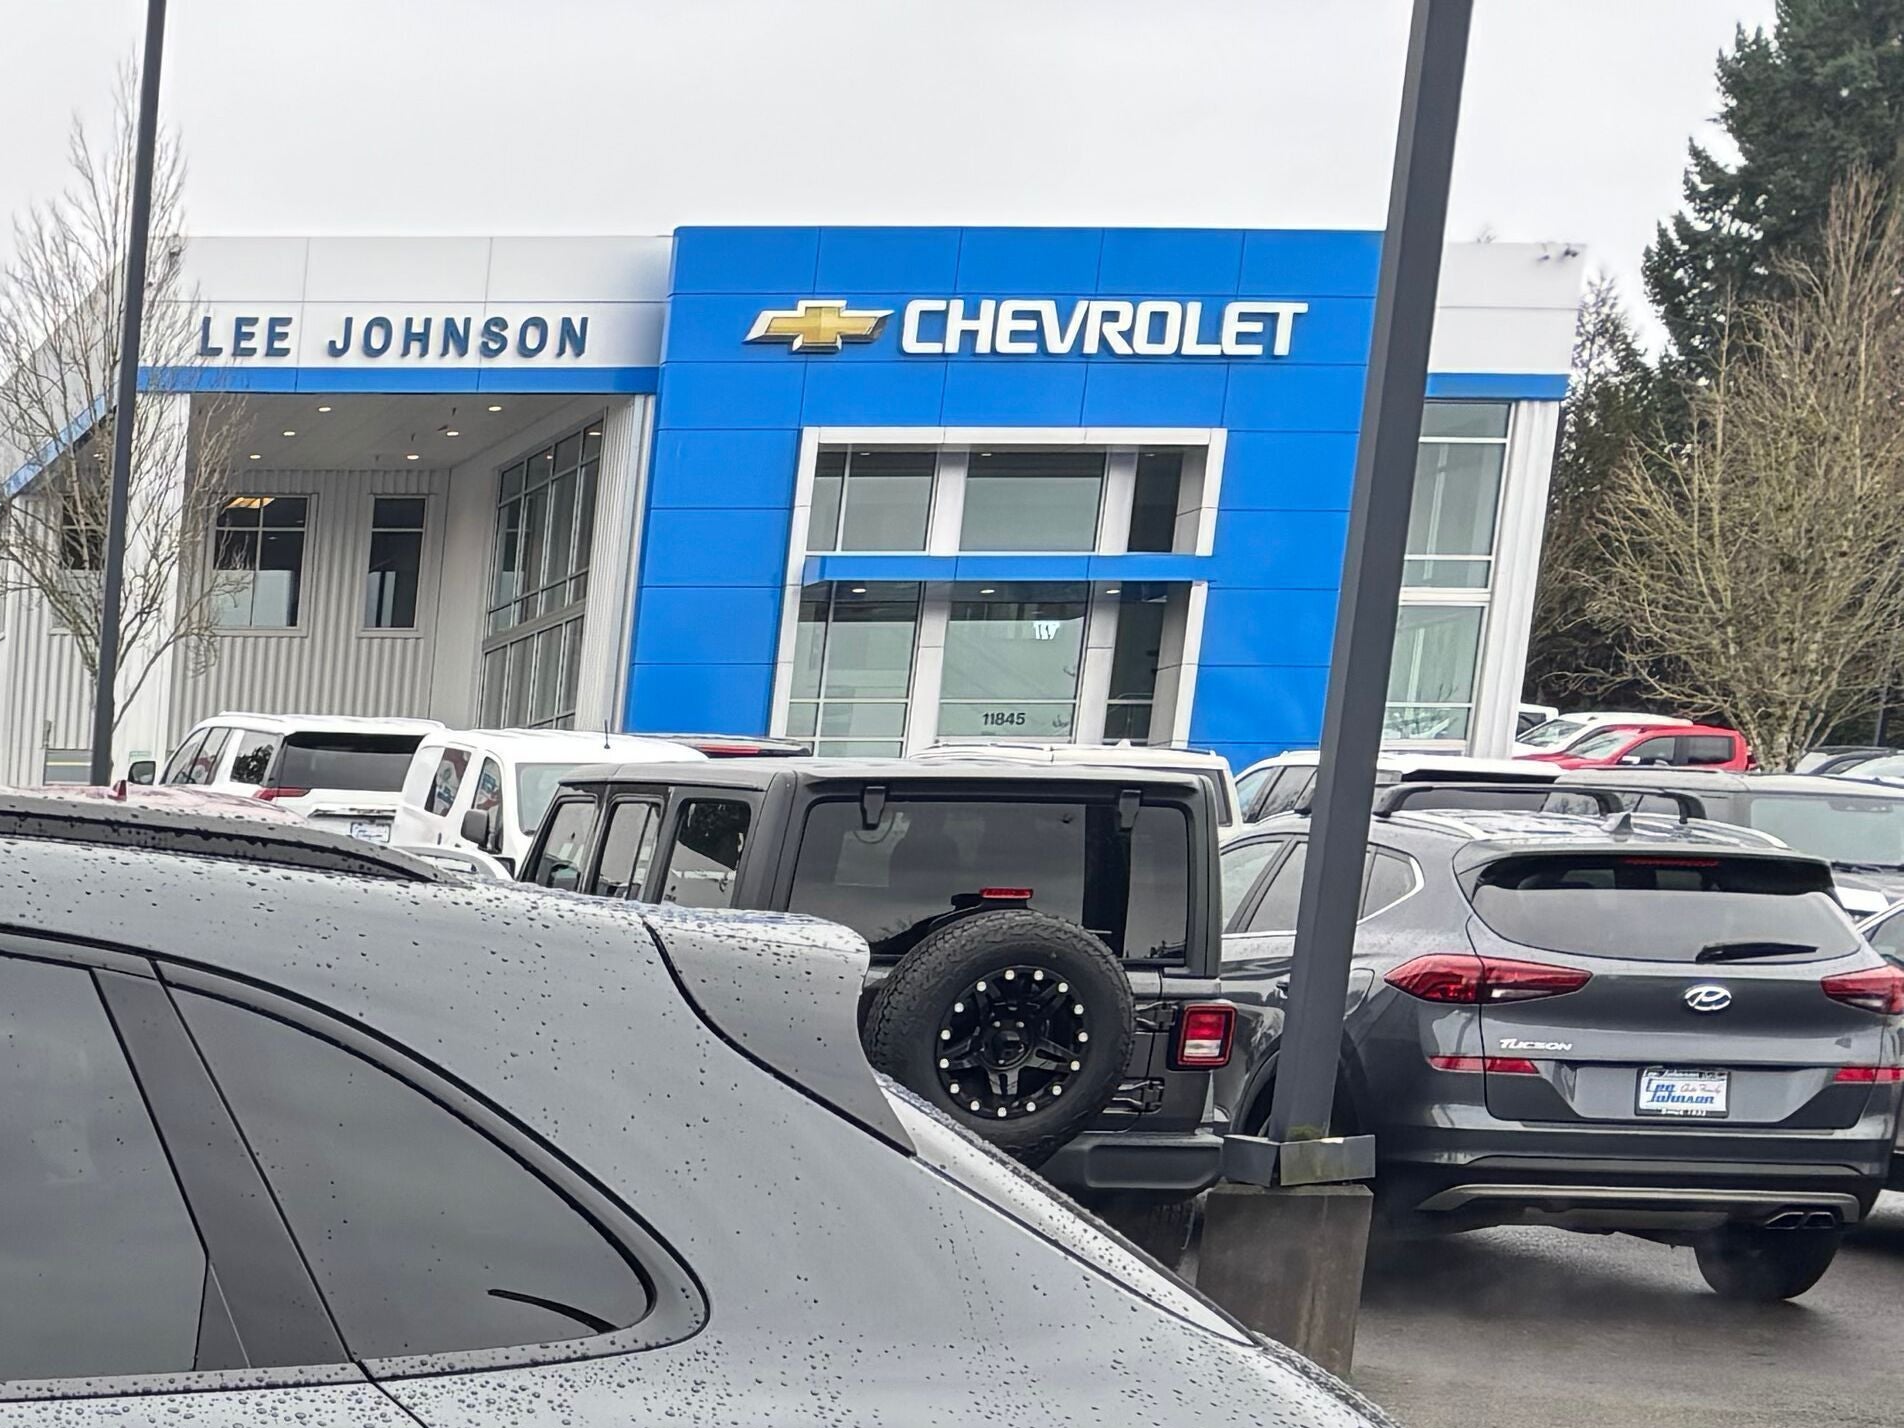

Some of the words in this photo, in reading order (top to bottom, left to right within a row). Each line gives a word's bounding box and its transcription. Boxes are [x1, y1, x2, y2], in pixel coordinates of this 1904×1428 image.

[199, 315, 293, 358] LEE
[327, 315, 590, 359] JOHNSON
[901, 299, 1309, 357] CHEVROLET
[982, 712, 1026, 726] 11845
[1499, 1038, 1573, 1051] TUCSON
